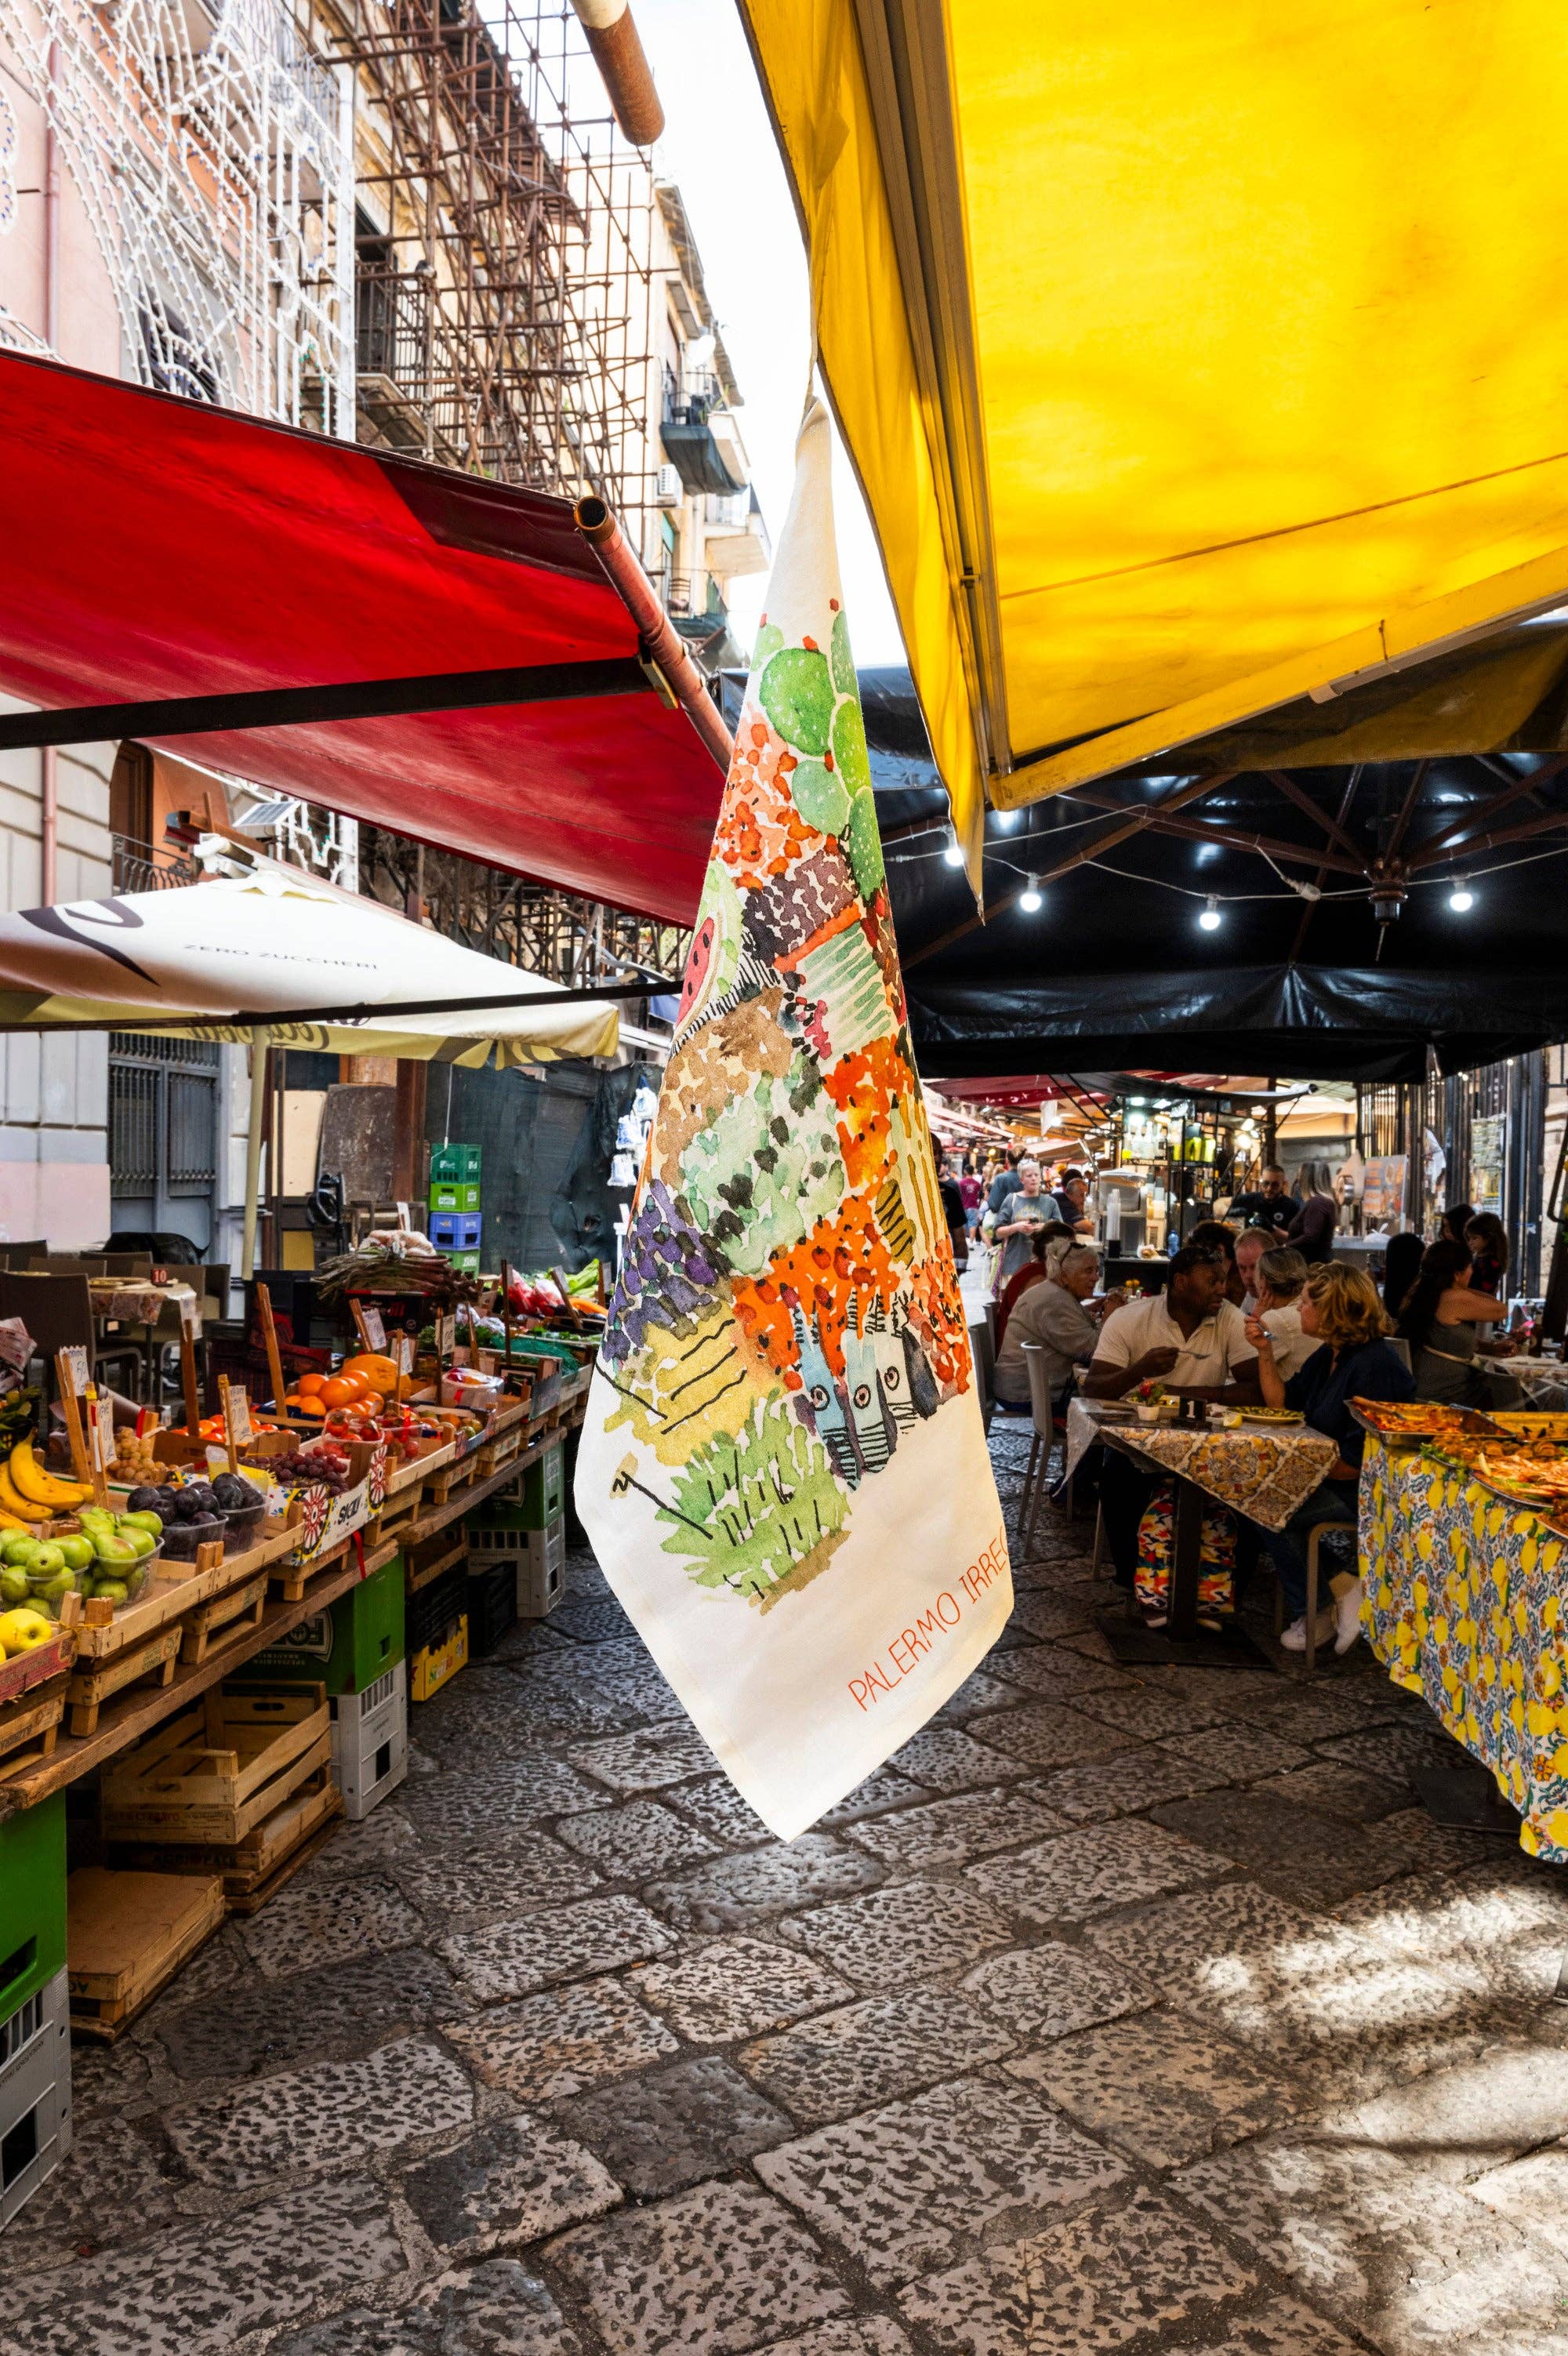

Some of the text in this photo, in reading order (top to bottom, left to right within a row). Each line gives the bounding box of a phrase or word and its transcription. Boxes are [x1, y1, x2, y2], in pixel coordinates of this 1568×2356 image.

[184, 944, 378, 970] ZERO ZUCCHERI
[153, 1269, 168, 1283] 10
[1186, 1400, 1196, 1418] 1
[848, 1592, 960, 1712] PALERMO
